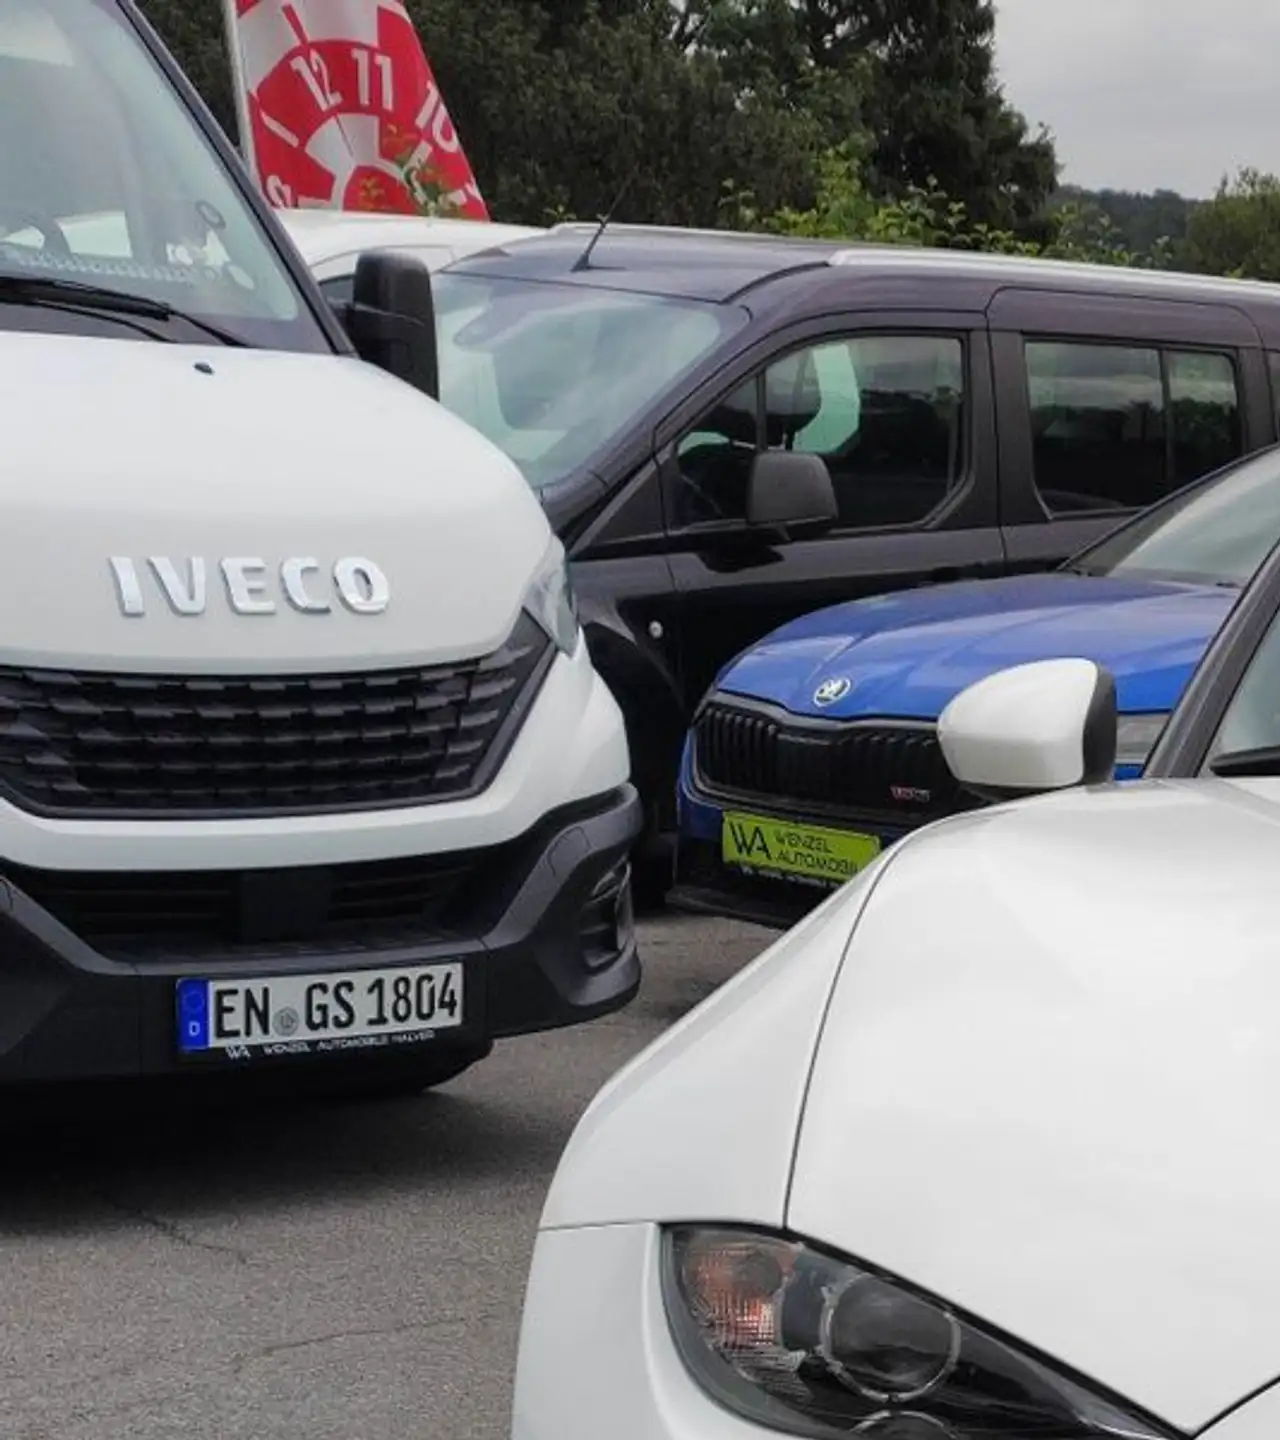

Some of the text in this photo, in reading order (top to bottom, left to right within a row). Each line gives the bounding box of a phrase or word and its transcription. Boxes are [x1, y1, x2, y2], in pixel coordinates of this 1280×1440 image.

[290, 49, 343, 112] 12
[352, 48, 394, 112] 11
[108, 556, 390, 616] IVECO
[729, 821, 771, 860] WA
[188, 1021, 201, 1037] D
[214, 971, 458, 1039] EN GS 1804
